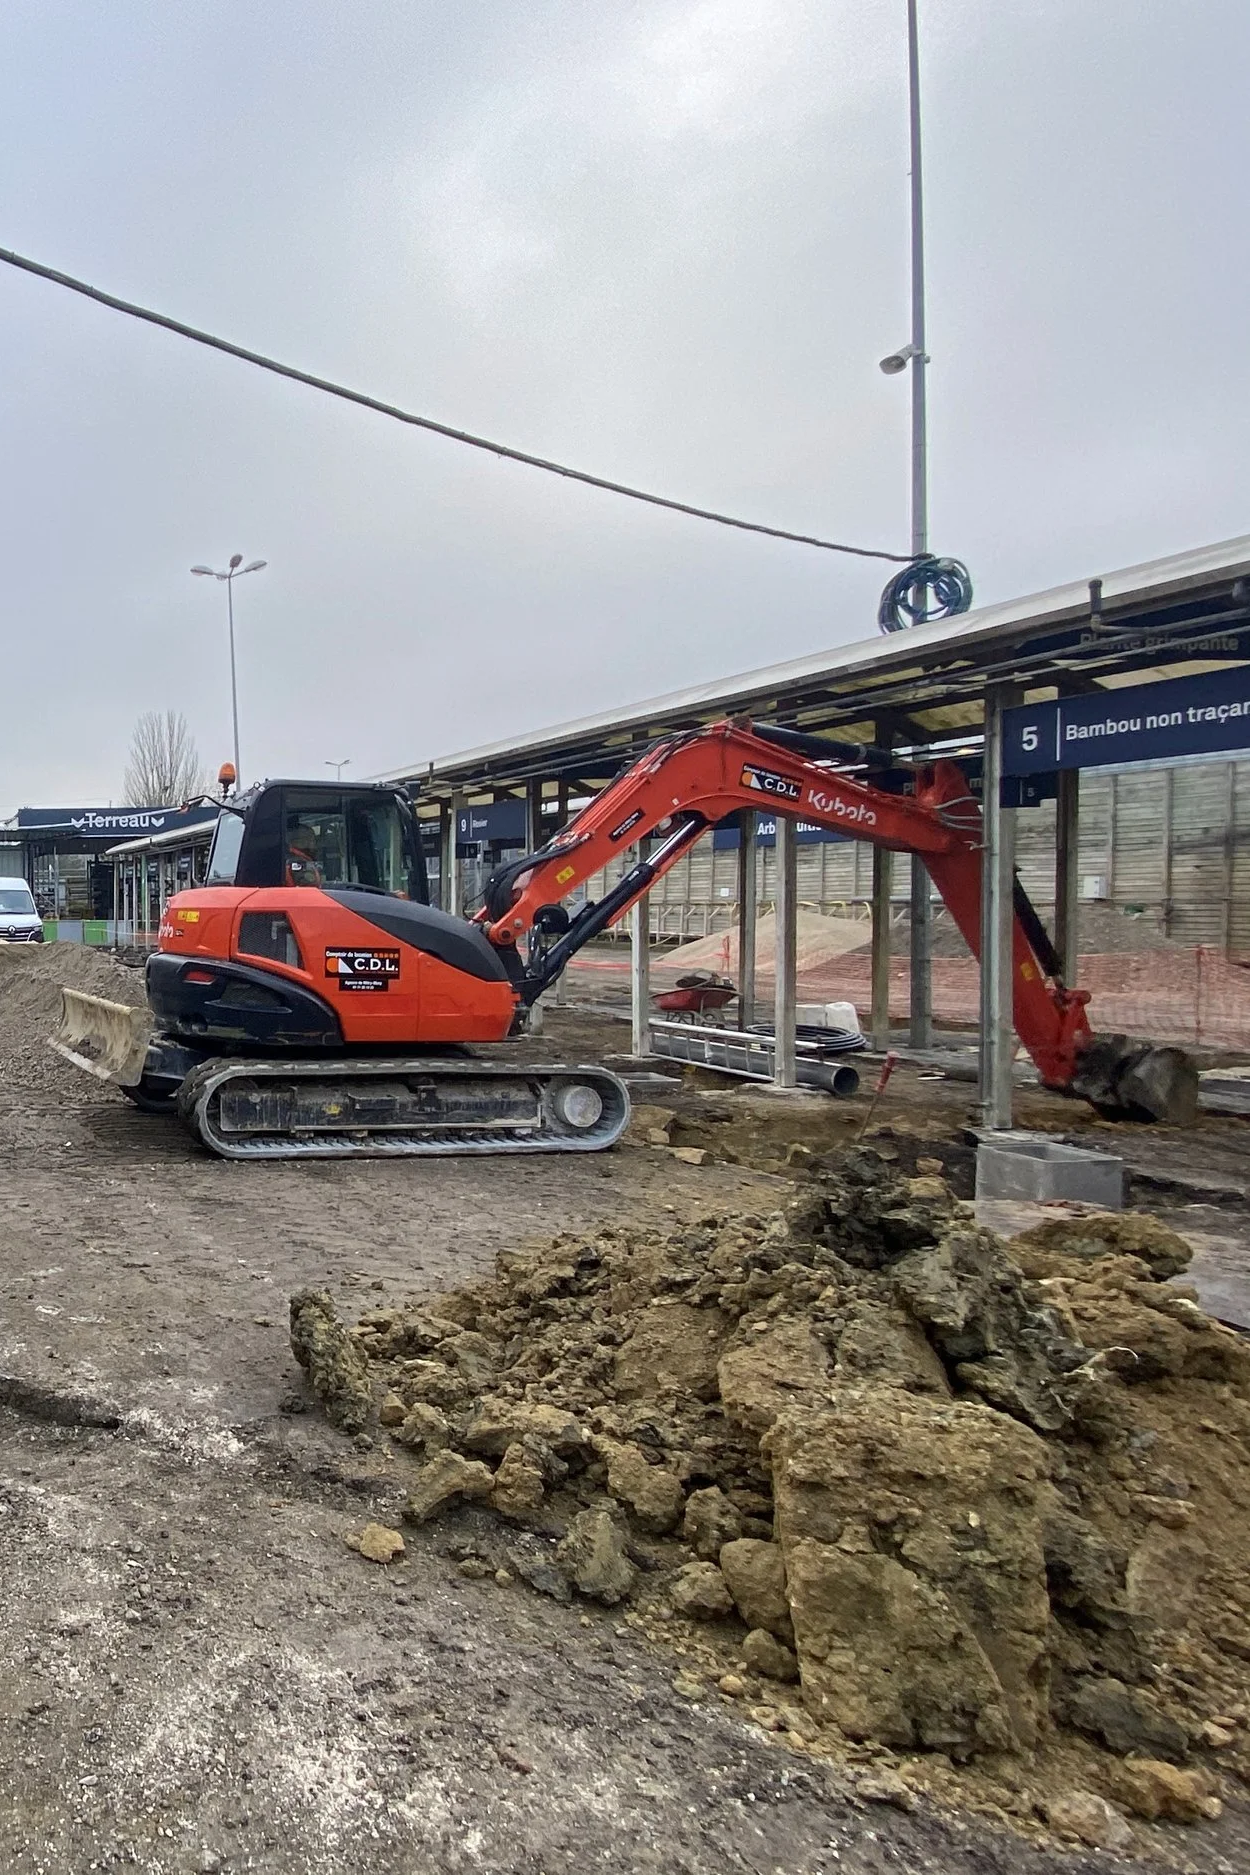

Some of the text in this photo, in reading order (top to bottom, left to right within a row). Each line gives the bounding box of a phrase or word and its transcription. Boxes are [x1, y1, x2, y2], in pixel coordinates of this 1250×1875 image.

[1065, 718, 1141, 741] Bambou
[1145, 711, 1182, 730] non
[1021, 726, 1039, 751] 5
[764, 778, 799, 798] C.D.L.
[808, 789, 877, 826] Kubota
[85, 812, 149, 828] Terreau
[461, 819, 467, 832] 9
[354, 958, 399, 971] C.D.L.
